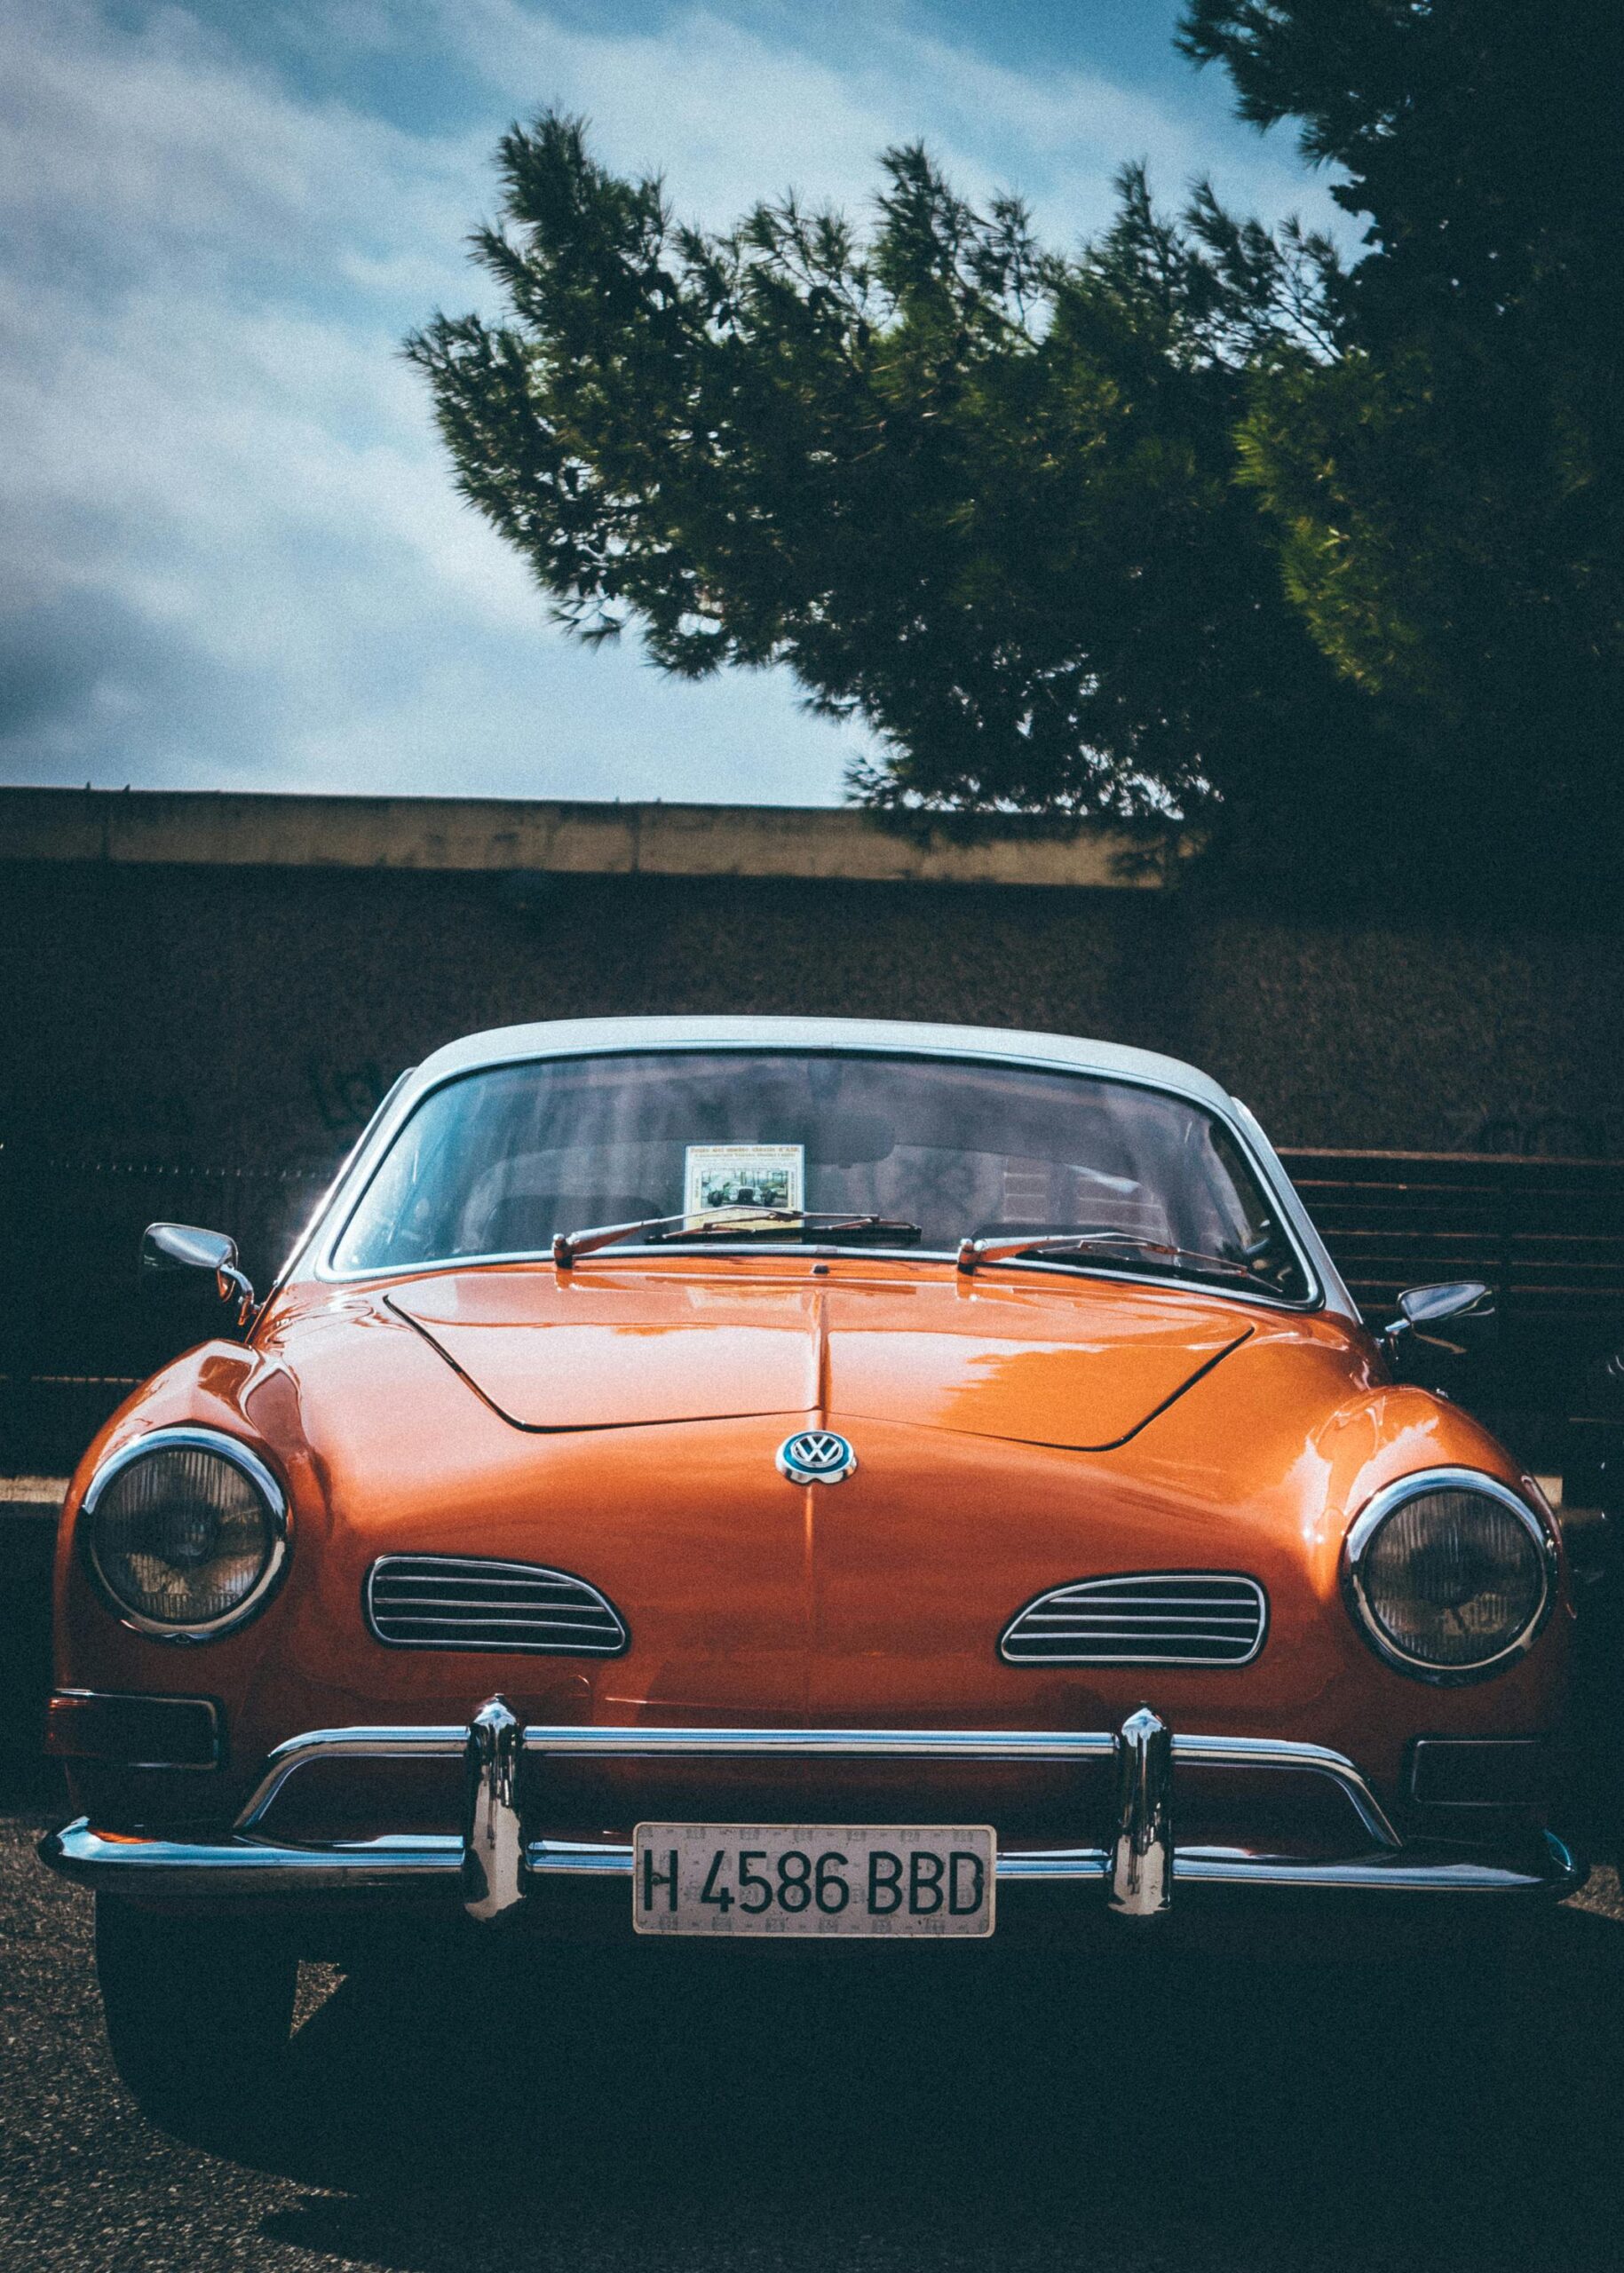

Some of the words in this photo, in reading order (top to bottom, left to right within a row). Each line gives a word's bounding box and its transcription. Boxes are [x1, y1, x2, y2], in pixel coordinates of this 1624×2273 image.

[793, 1434, 841, 1463] VW
[643, 1849, 679, 1913] H
[700, 1849, 851, 1914] 4586
[867, 1850, 986, 1916] BBD
